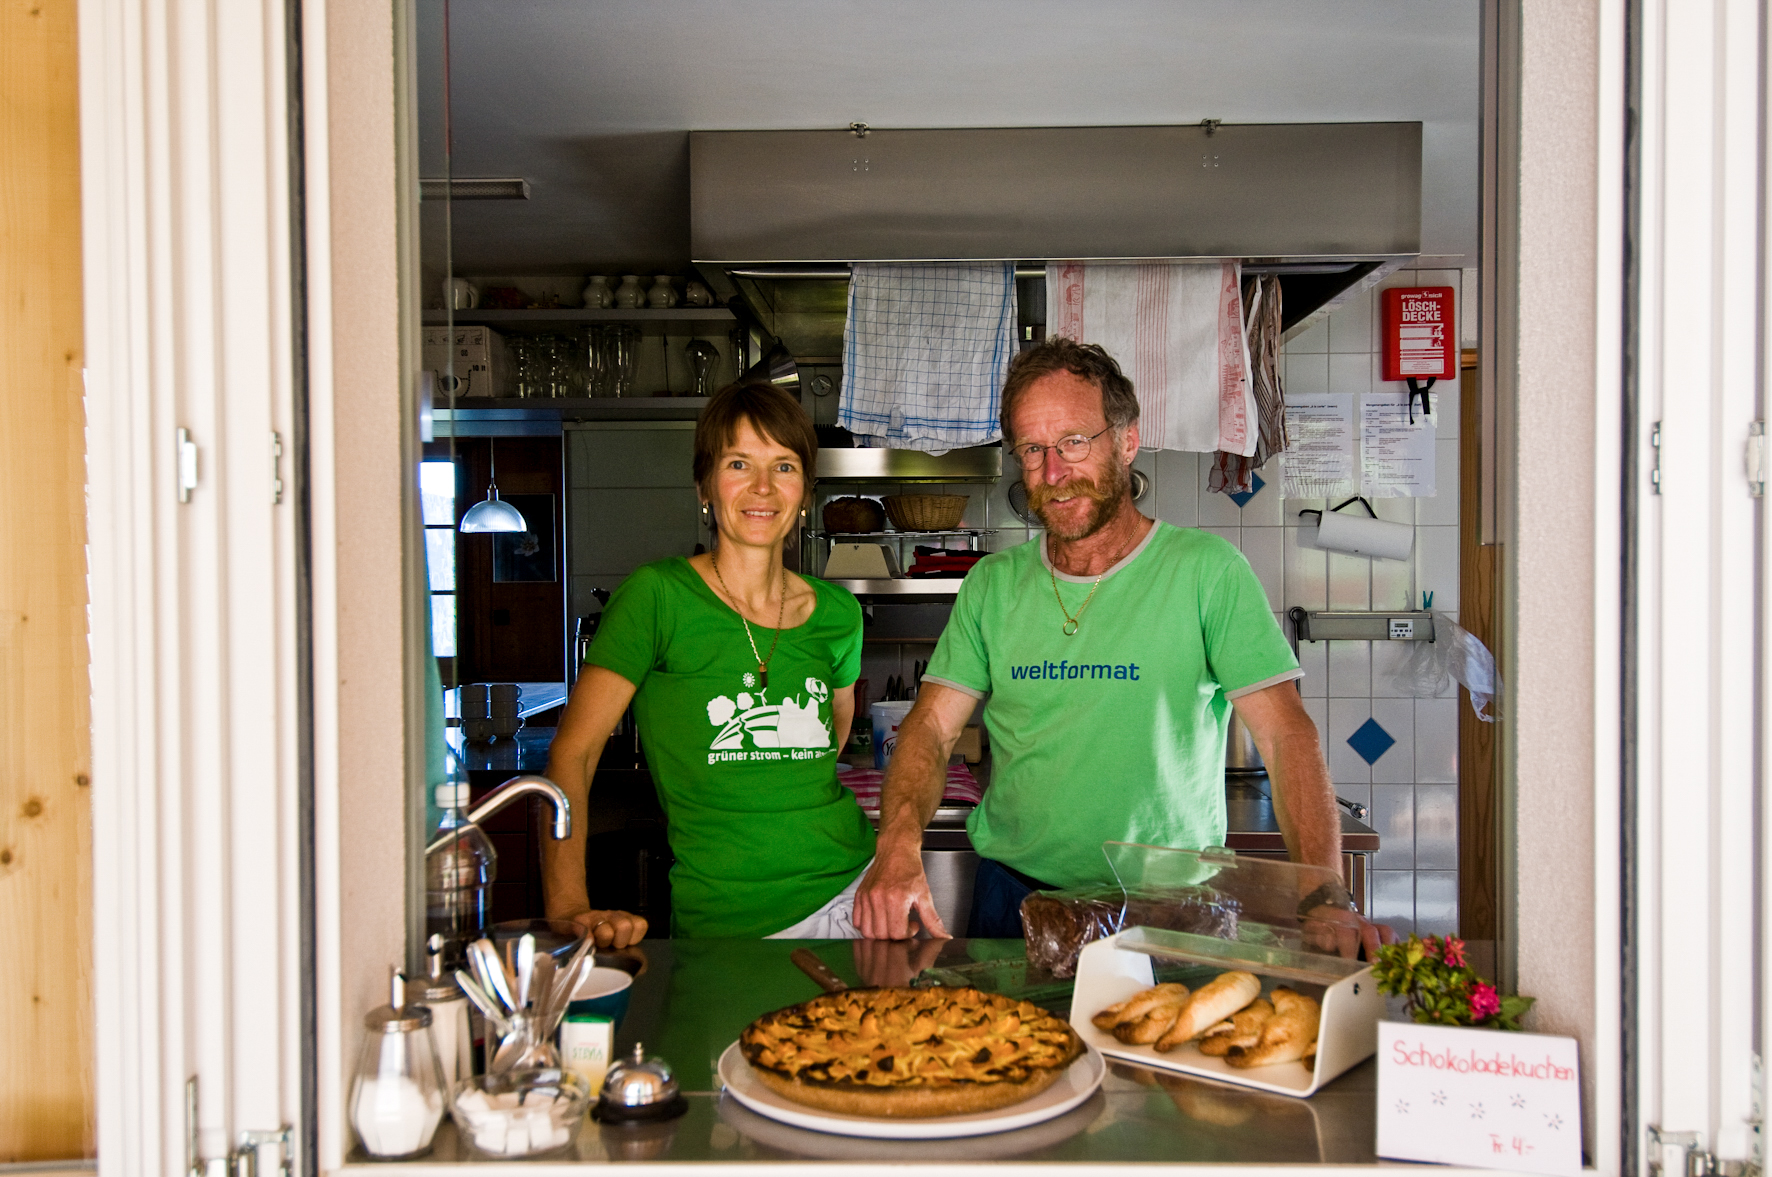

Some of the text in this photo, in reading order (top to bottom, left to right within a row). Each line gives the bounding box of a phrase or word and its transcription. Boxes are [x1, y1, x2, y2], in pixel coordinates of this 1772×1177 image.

[1402, 299, 1441, 311] LÖSCH-
[1402, 311, 1441, 321] DECKE
[1011, 660, 1140, 681] weltformat
[707, 750, 747, 765] grüner
[750, 750, 781, 761] strom
[791, 748, 814, 760] kein
[1393, 1039, 1575, 1081] Schokoladekuchen
